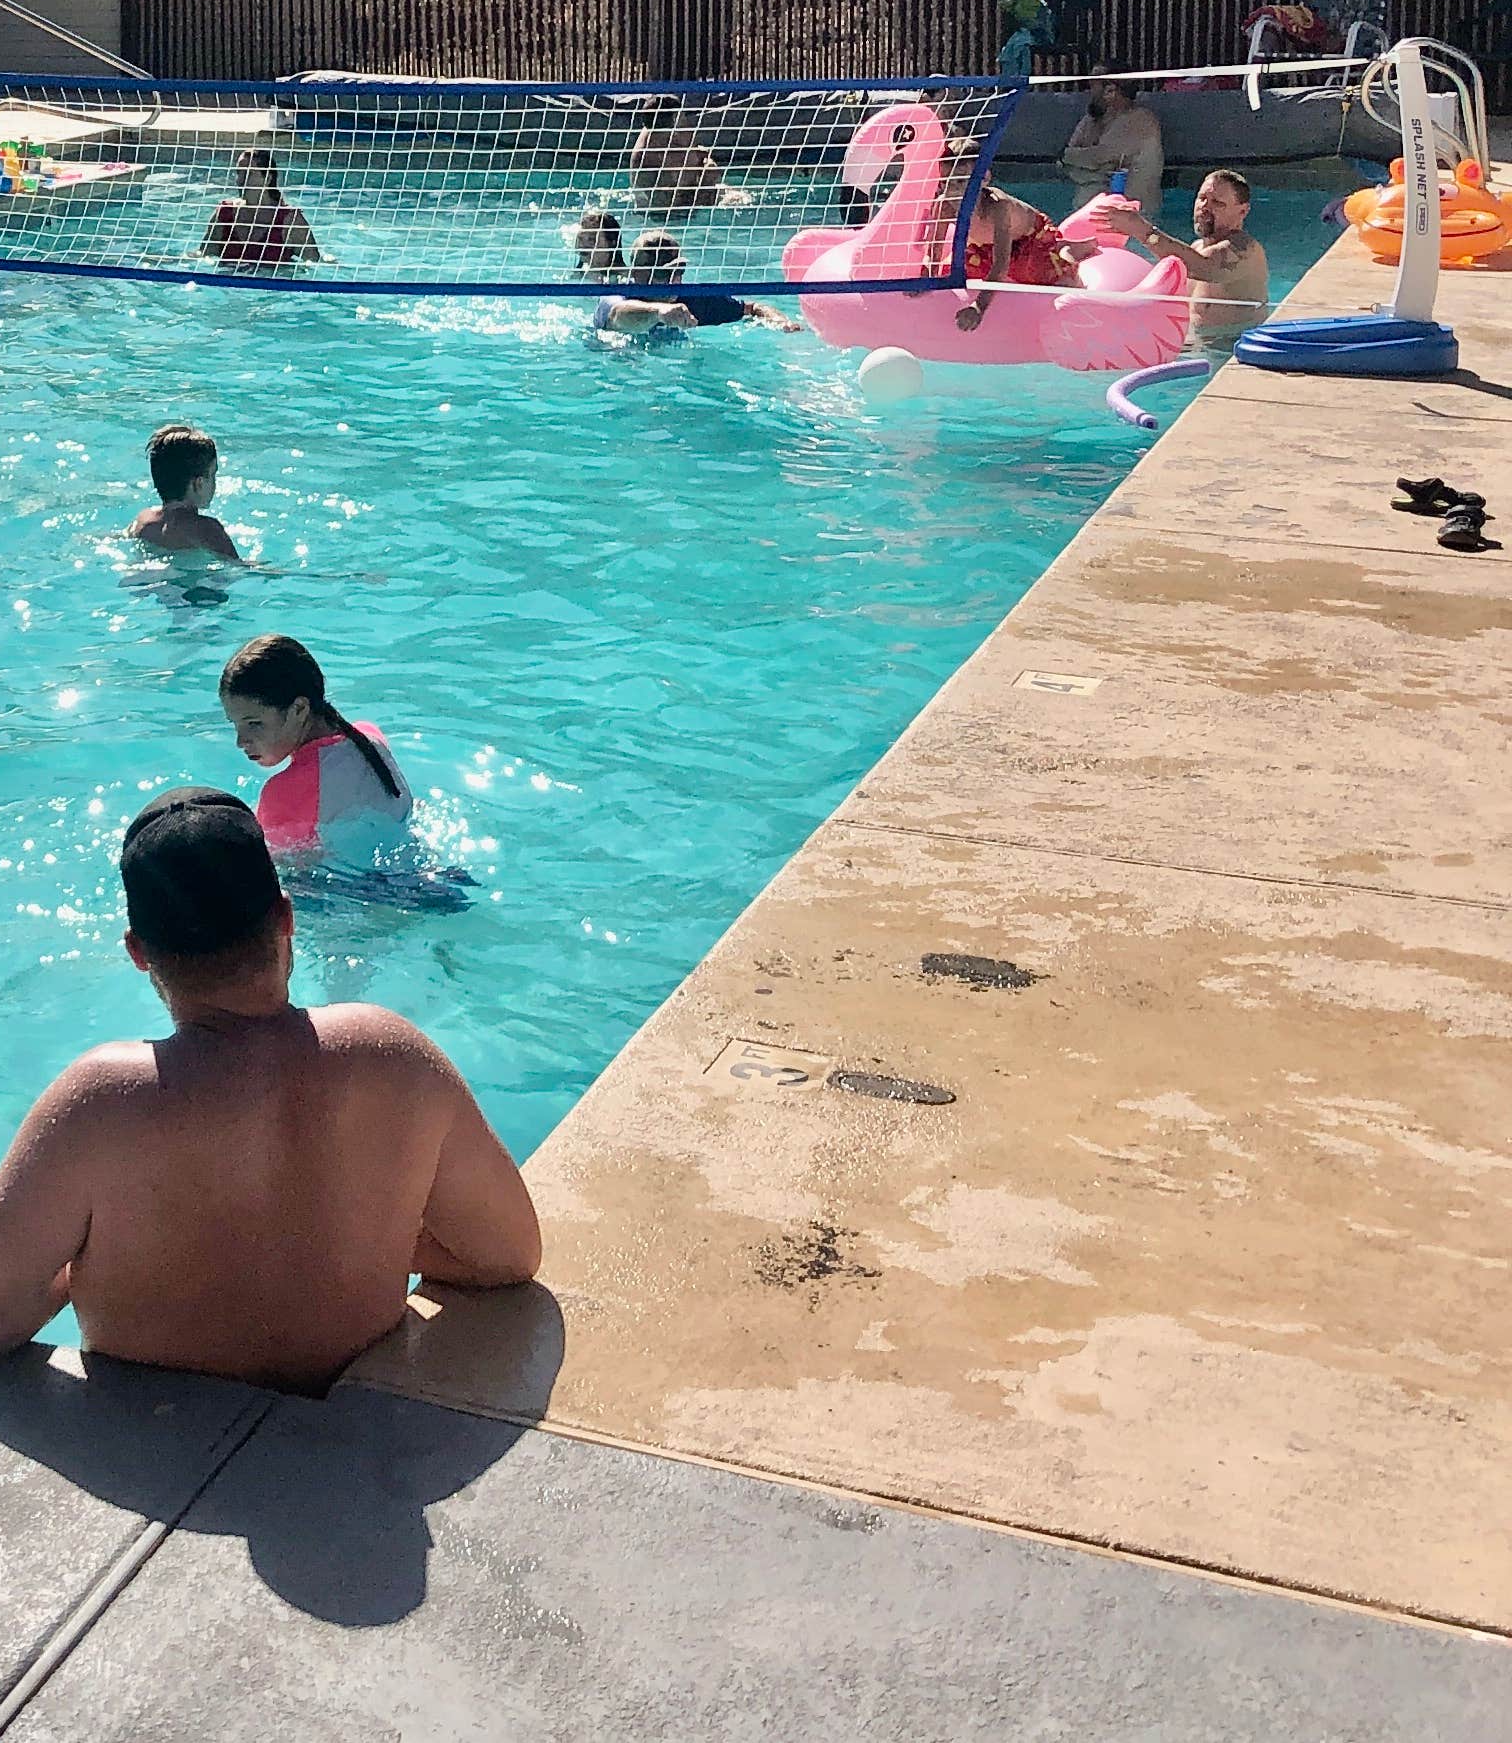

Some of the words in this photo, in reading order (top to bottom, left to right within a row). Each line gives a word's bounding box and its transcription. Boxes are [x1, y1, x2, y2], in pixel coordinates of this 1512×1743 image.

[1411, 118, 1426, 170] SPLASH
[1417, 173, 1427, 200] NET
[1031, 680, 1085, 693] 4
[741, 1045, 771, 1059] FT
[729, 1062, 809, 1086] 3
